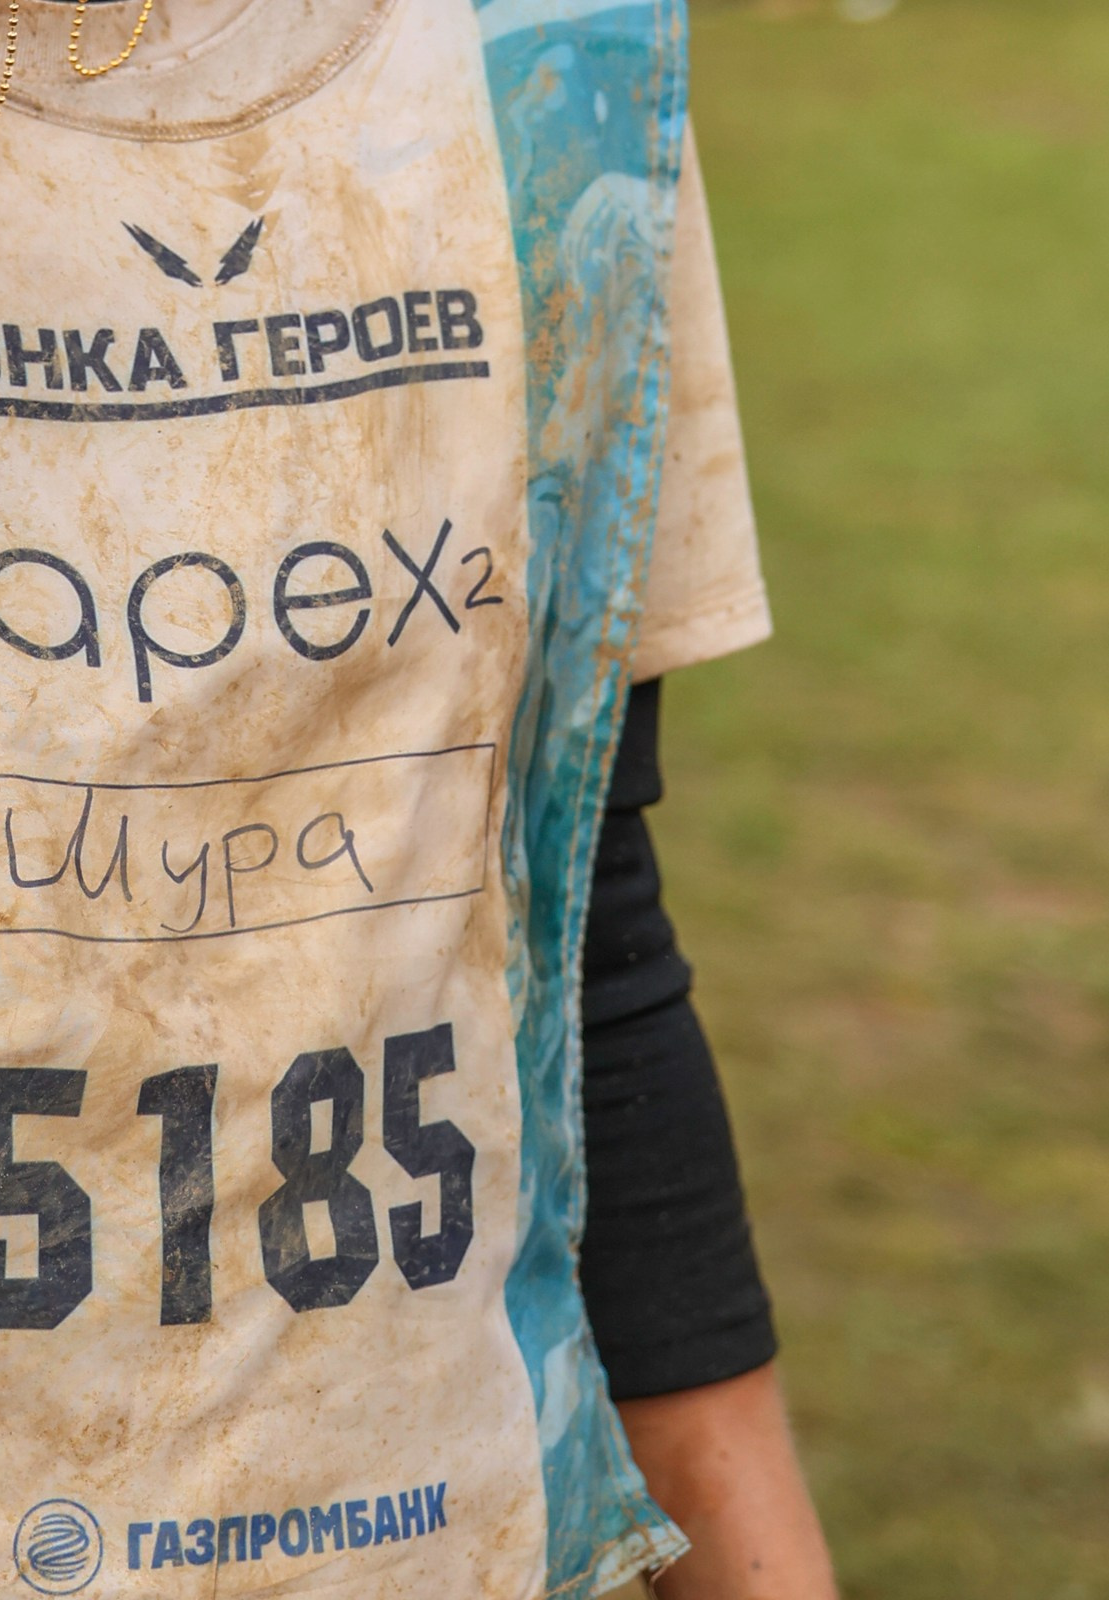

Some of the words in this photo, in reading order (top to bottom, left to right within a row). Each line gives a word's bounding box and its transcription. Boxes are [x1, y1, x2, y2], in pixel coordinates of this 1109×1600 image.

[213, 289, 484, 381] ГЕРОЕВ
[5, 787, 374, 933] Шура
[127, 1481, 448, 1571] ГАЗПРОМБАНК
